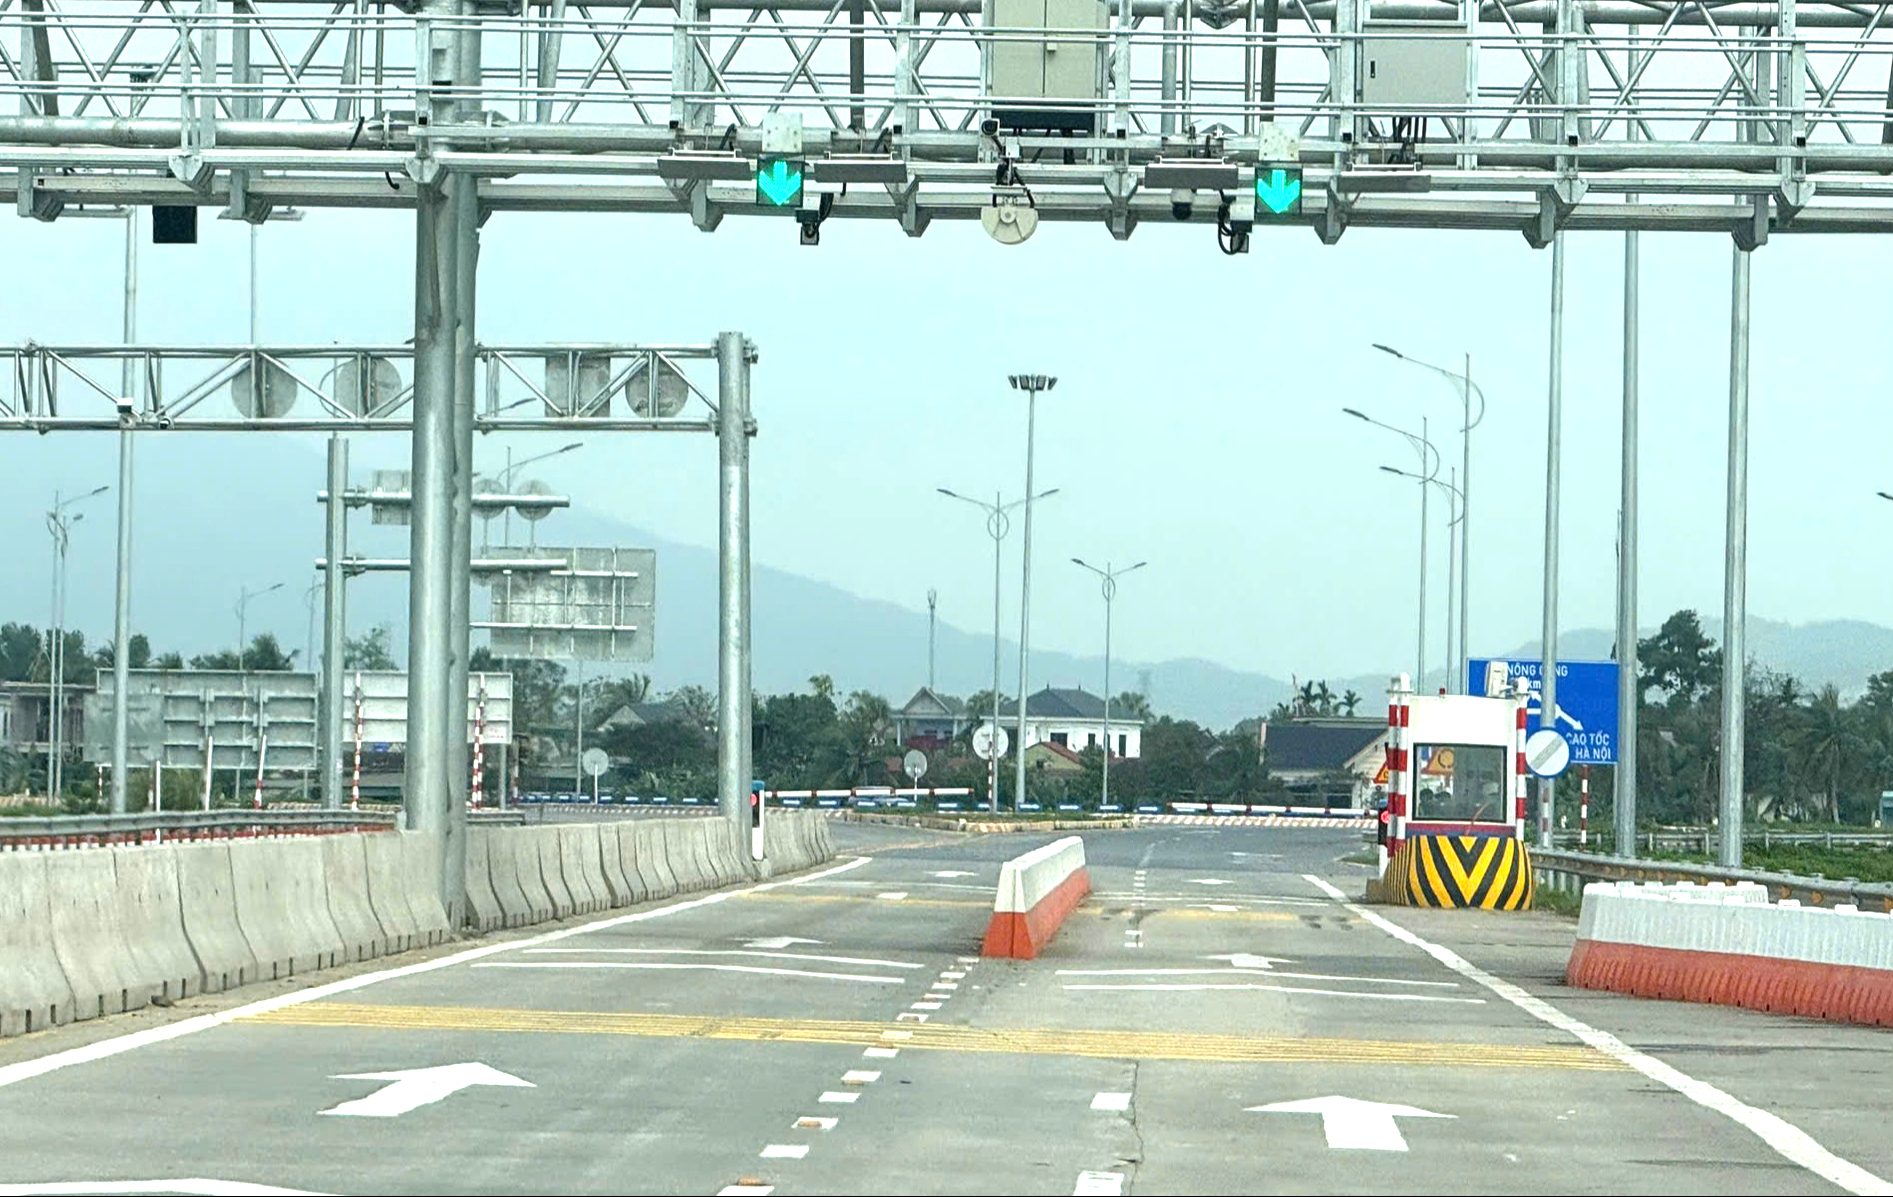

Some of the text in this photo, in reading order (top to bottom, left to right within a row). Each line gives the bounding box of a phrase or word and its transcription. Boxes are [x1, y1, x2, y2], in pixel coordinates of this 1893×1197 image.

[1589, 729, 1610, 746] TỐC
[1575, 744, 1611, 761] HÀ NỘI
